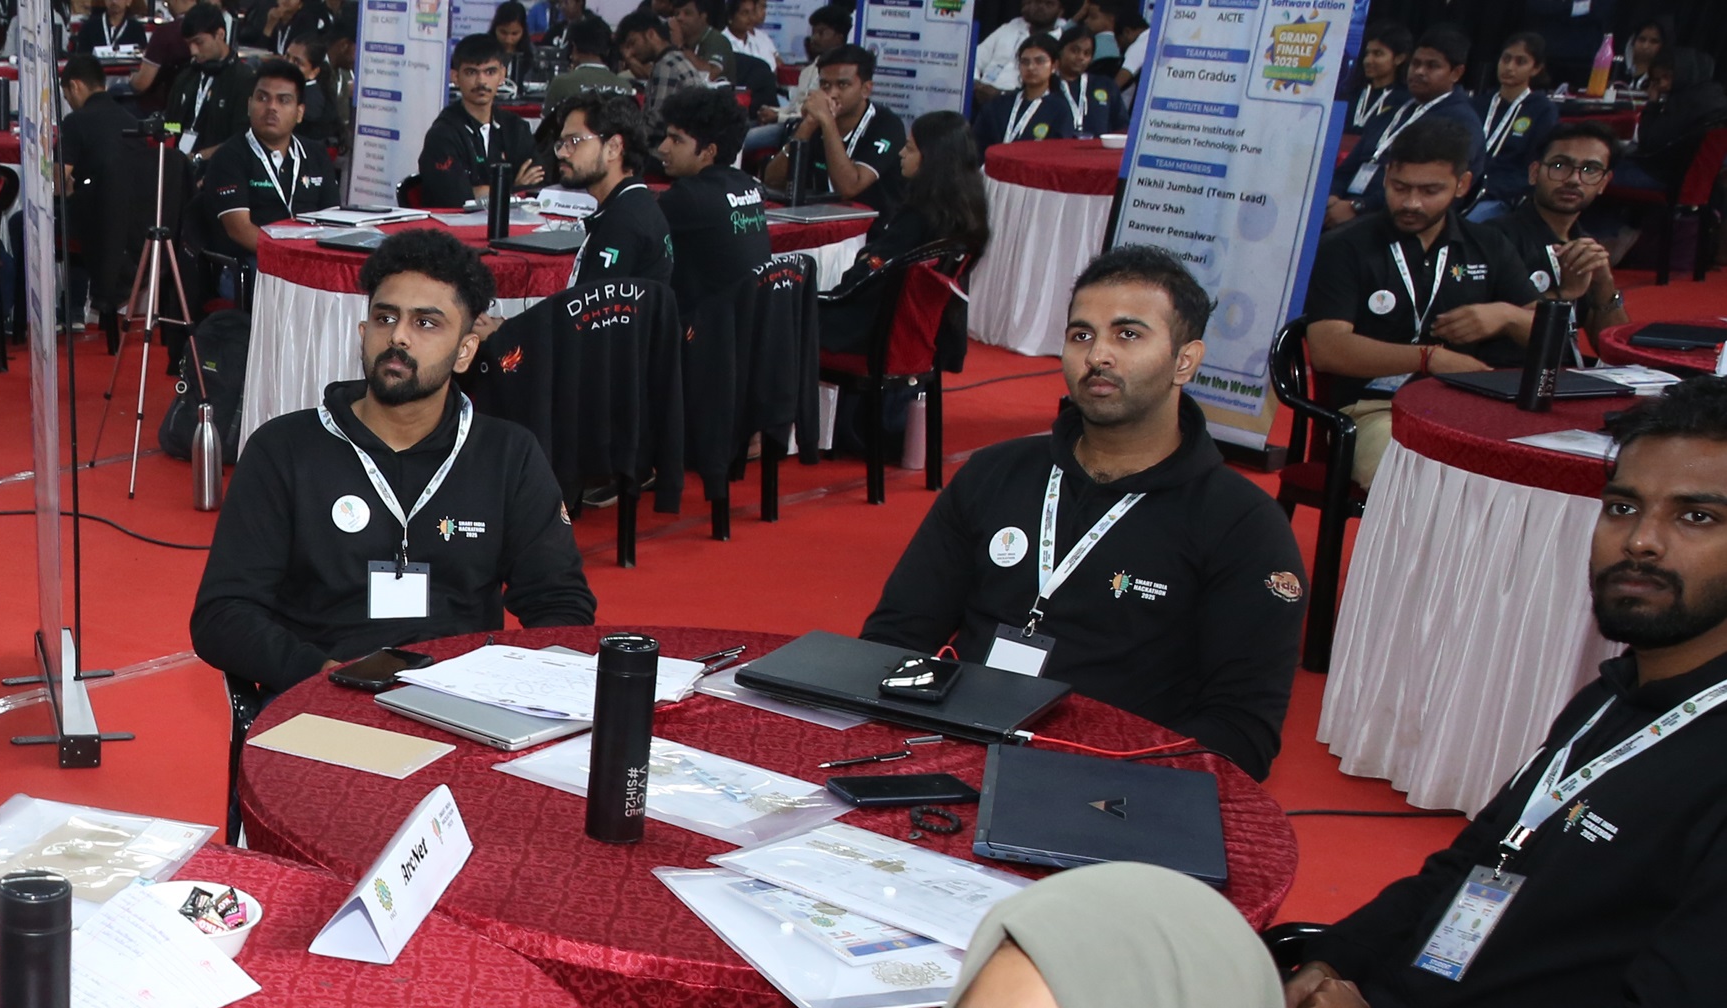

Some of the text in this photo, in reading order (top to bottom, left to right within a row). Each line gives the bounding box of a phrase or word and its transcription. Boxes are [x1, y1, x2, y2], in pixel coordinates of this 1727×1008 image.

[1217, 13, 1244, 23] AICTE
[1279, 31, 1318, 44] GRAND
[1185, 49, 1229, 60] TEAM NAME
[1276, 45, 1312, 57] FINALE
[1274, 57, 1299, 68] 2025
[1166, 67, 1237, 83] Team Gradus
[1167, 101, 1226, 115] INSTITUTE NAME
[1149, 119, 1246, 138] Vishwakarma Institute of
[1146, 133, 1263, 155] Information Technology, Pune
[1155, 159, 1212, 174] TEAM MEMBERS
[250, 179, 274, 188] Gradu
[1137, 177, 1267, 206] Nikhil Jumbad (Team Lead)
[1132, 199, 1186, 215] Dhruv Shah
[1128, 220, 1217, 243] Ranveer Pensalwar
[566, 283, 646, 317] DHRUV
[1196, 371, 1263, 398] for the World
[1133, 584, 1167, 597] HACKATHON
[1134, 577, 1168, 591] SMART INDIA
[1141, 592, 1156, 601] 2025
[624, 767, 639, 817] #SIH25
[634, 764, 648, 816] VVCE
[400, 836, 428, 887] ArcNet
